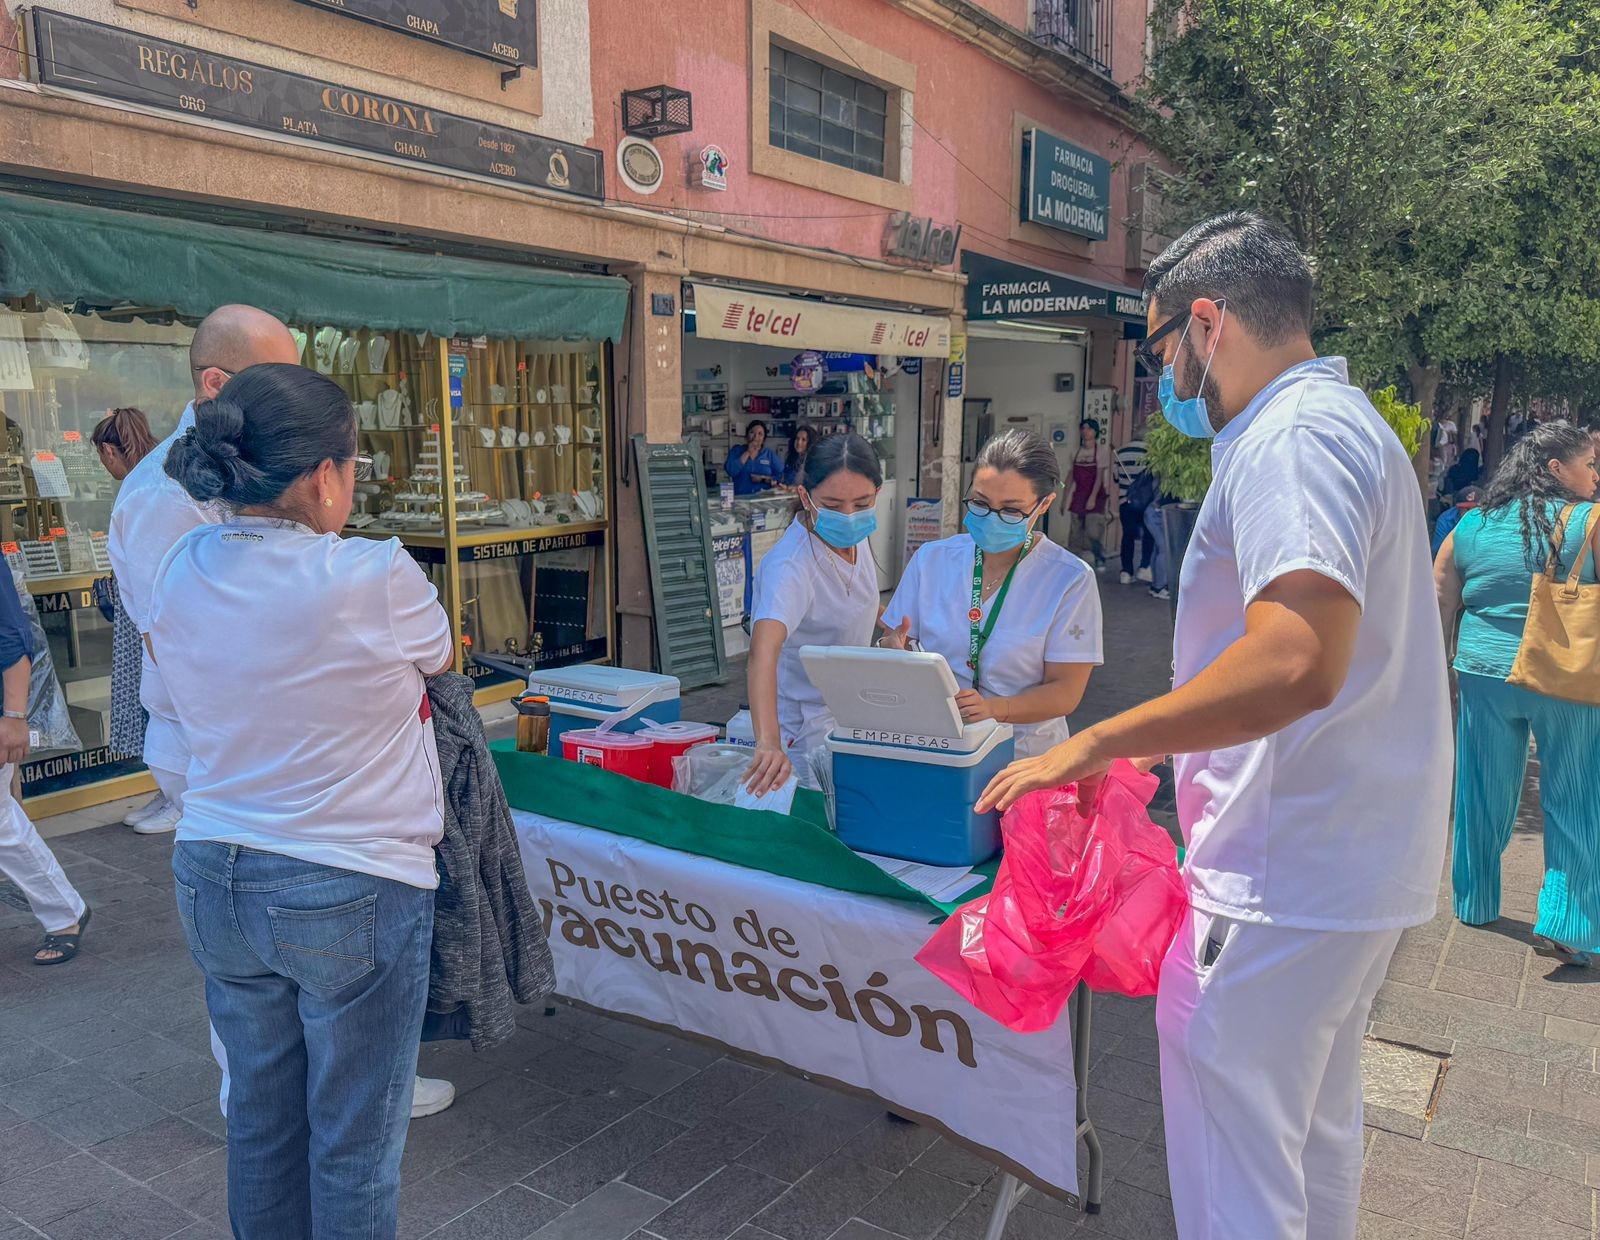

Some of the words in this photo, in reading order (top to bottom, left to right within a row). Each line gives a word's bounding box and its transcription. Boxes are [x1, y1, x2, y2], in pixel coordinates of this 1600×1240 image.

[406, 14, 440, 36] CHAPA
[491, 42, 520, 60] ACERO
[137, 45, 254, 95] REGALOS
[179, 94, 206, 113] ORO
[321, 87, 436, 134] CORONA
[282, 116, 319, 136] PLATA
[394, 141, 427, 159] CHAPA
[478, 136, 499, 151] Desde
[500, 142, 516, 155] 1927
[489, 162, 516, 177] ACERO
[1054, 146, 1094, 176] FARMACIA
[1050, 170, 1096, 200] DROGUERIA
[1037, 193, 1052, 219] LA
[1054, 199, 1105, 235] MODERNA
[982, 281, 1051, 297] FARMACIA
[982, 300, 1004, 315] LA
[1007, 296, 1090, 313] MODERNA
[1116, 295, 1148, 316] FARMAC
[746, 306, 802, 337] telcel
[889, 323, 930, 348] tlcel
[473, 542, 519, 560] SISTEMA
[523, 540, 536, 553] DE
[539, 534, 587, 552] APARTADO
[970, 634, 978, 655] IMSS
[539, 685, 604, 704] EMPRESAS
[853, 729, 950, 749] EMPRESAS
[545, 857, 716, 933] Puesto
[733, 909, 800, 959] de
[538, 897, 978, 1069] vacunación
